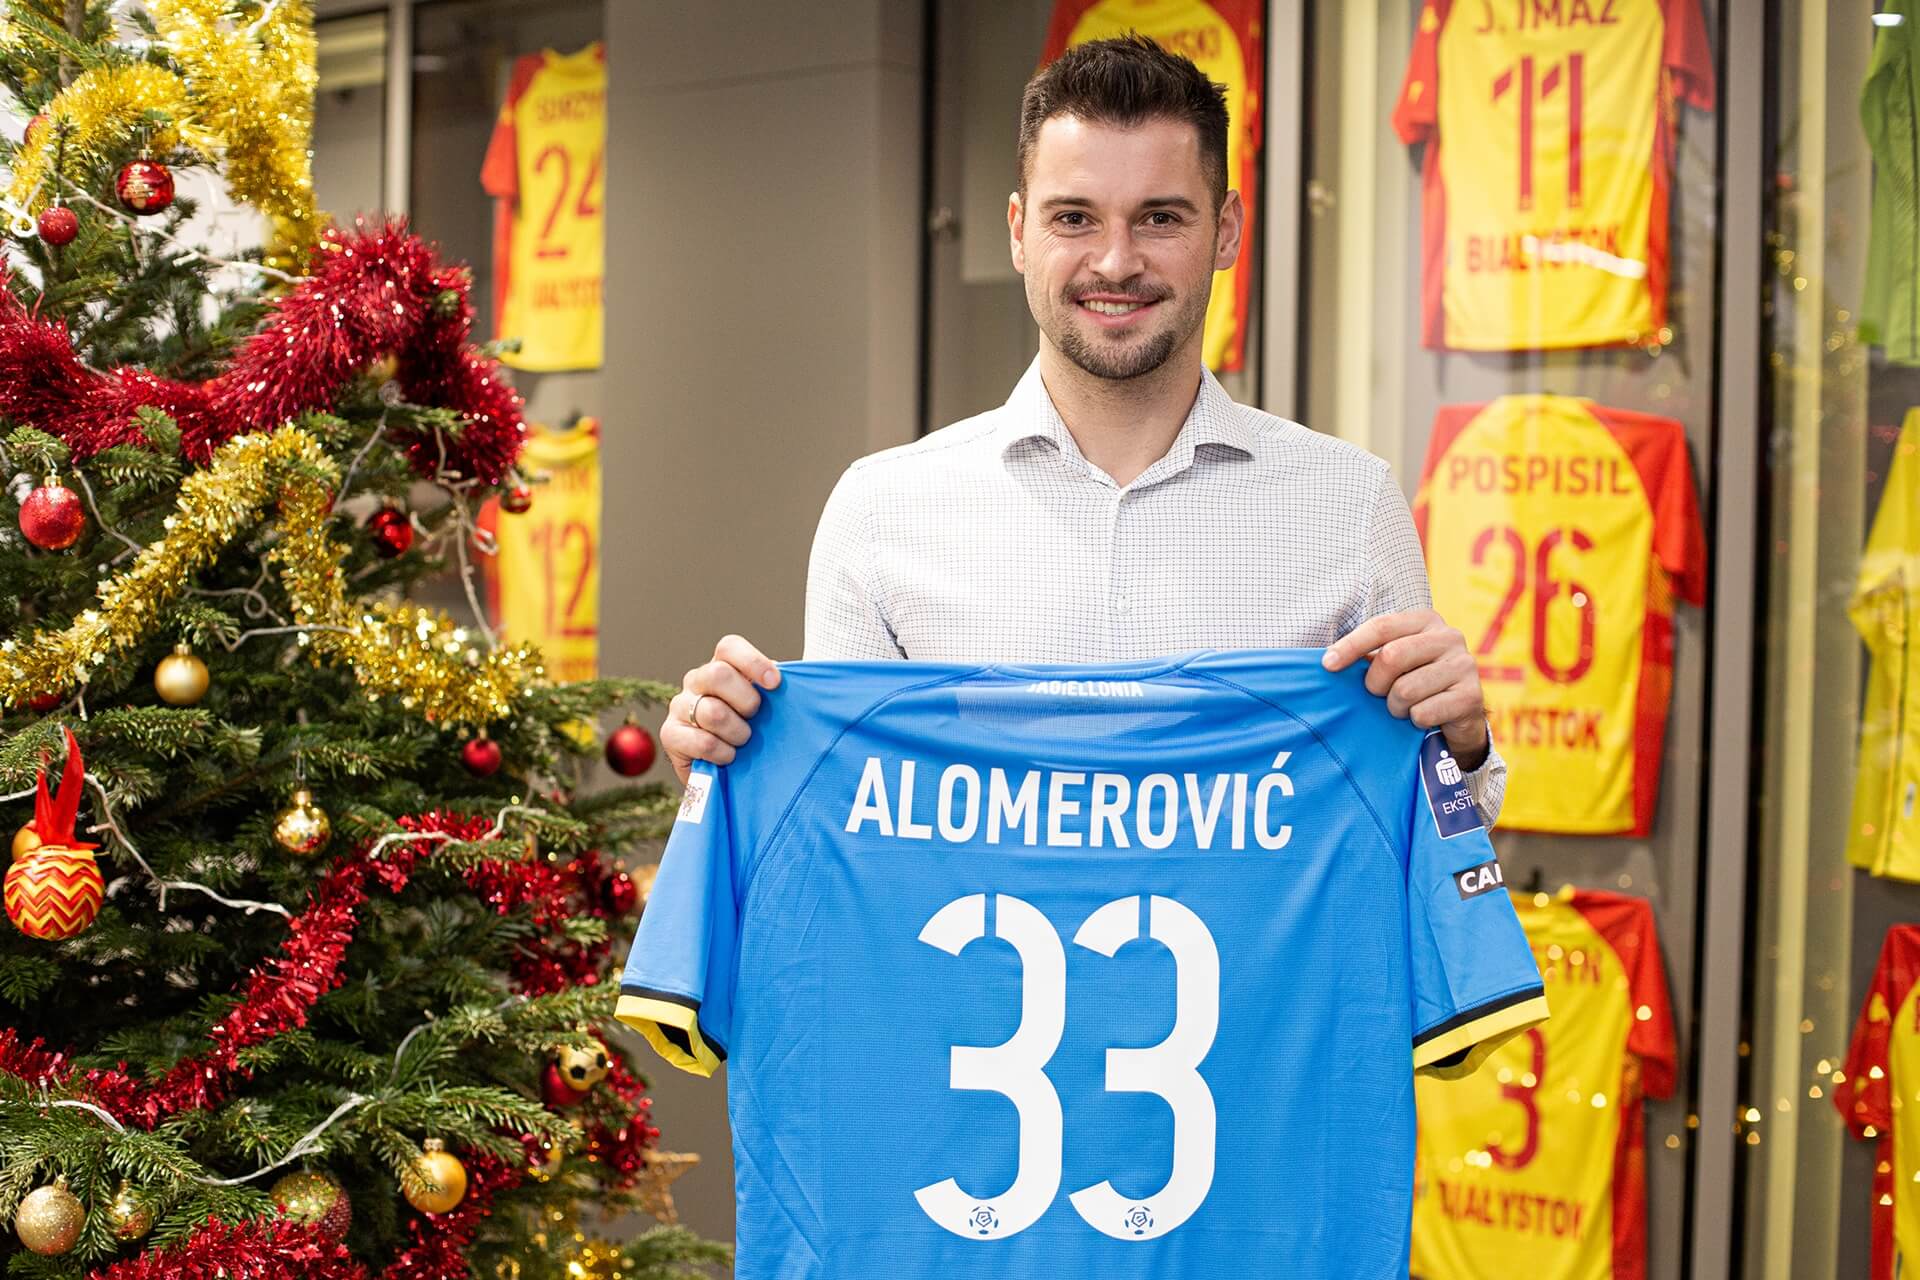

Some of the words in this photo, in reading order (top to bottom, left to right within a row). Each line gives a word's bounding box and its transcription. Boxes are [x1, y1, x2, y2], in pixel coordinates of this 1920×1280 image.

[1492, 52, 1584, 211] 11
[1448, 457, 1631, 495] POSPISIL
[530, 521, 597, 637] 12
[1471, 526, 1596, 684] 26
[845, 752, 1295, 850] ALOMEROVIĆ
[914, 893, 1220, 1241] 33
[1485, 1028, 1545, 1171] 3
